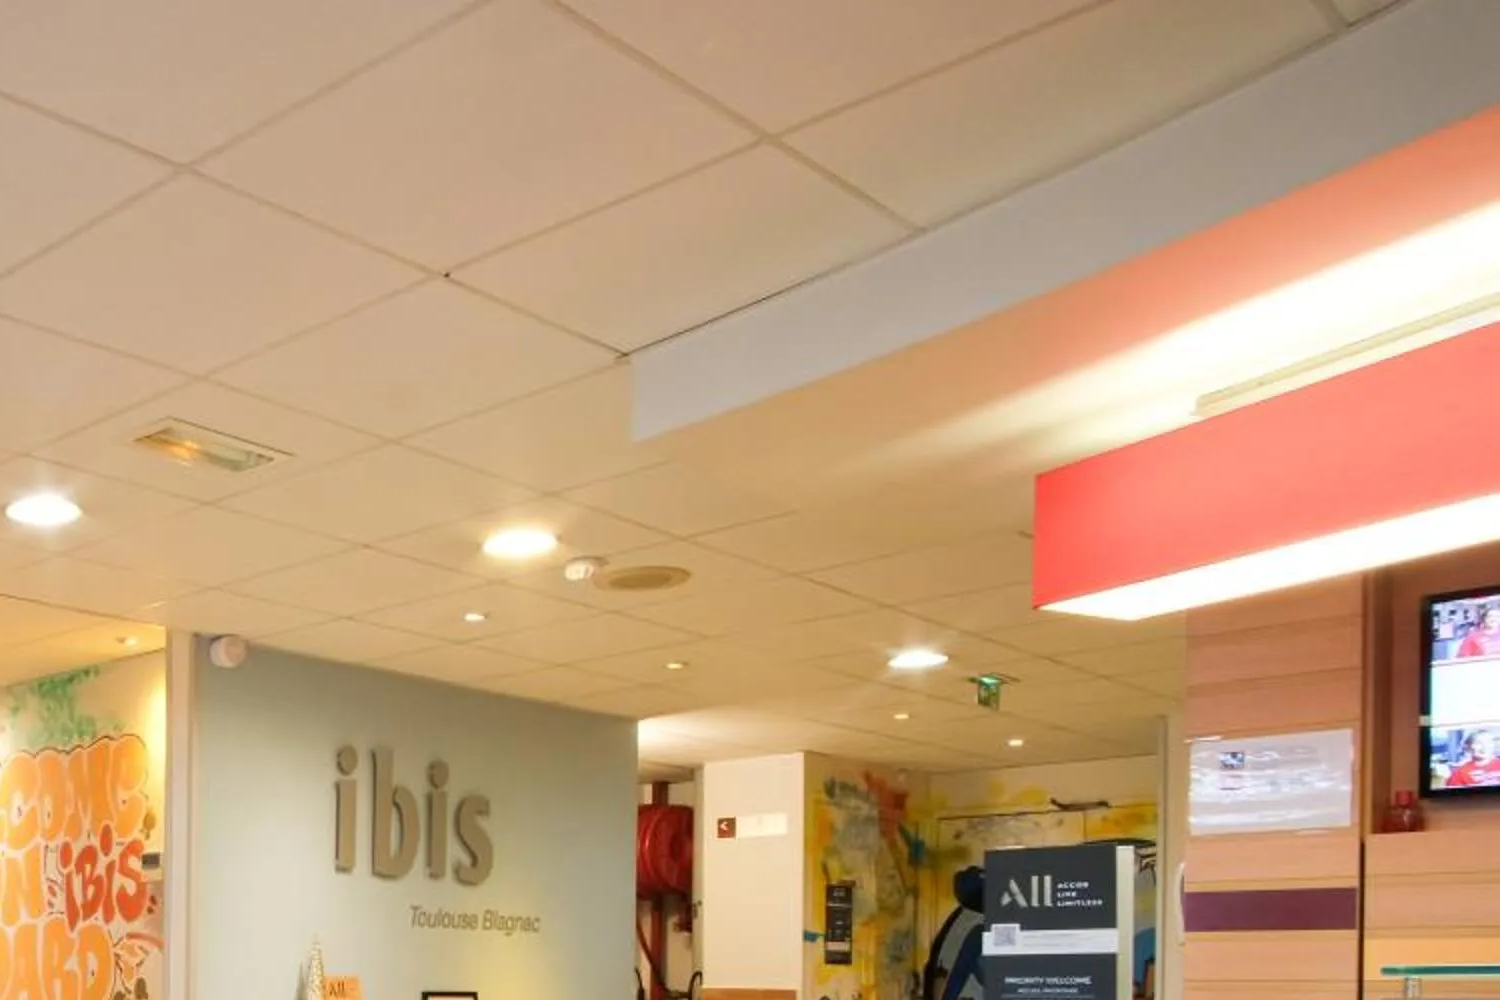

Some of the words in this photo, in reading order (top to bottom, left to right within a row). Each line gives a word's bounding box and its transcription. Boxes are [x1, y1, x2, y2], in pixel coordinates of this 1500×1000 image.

[334, 745, 494, 886] ibis
[409, 904, 478, 930] Toulouse
[482, 908, 541, 937] Blagnac
